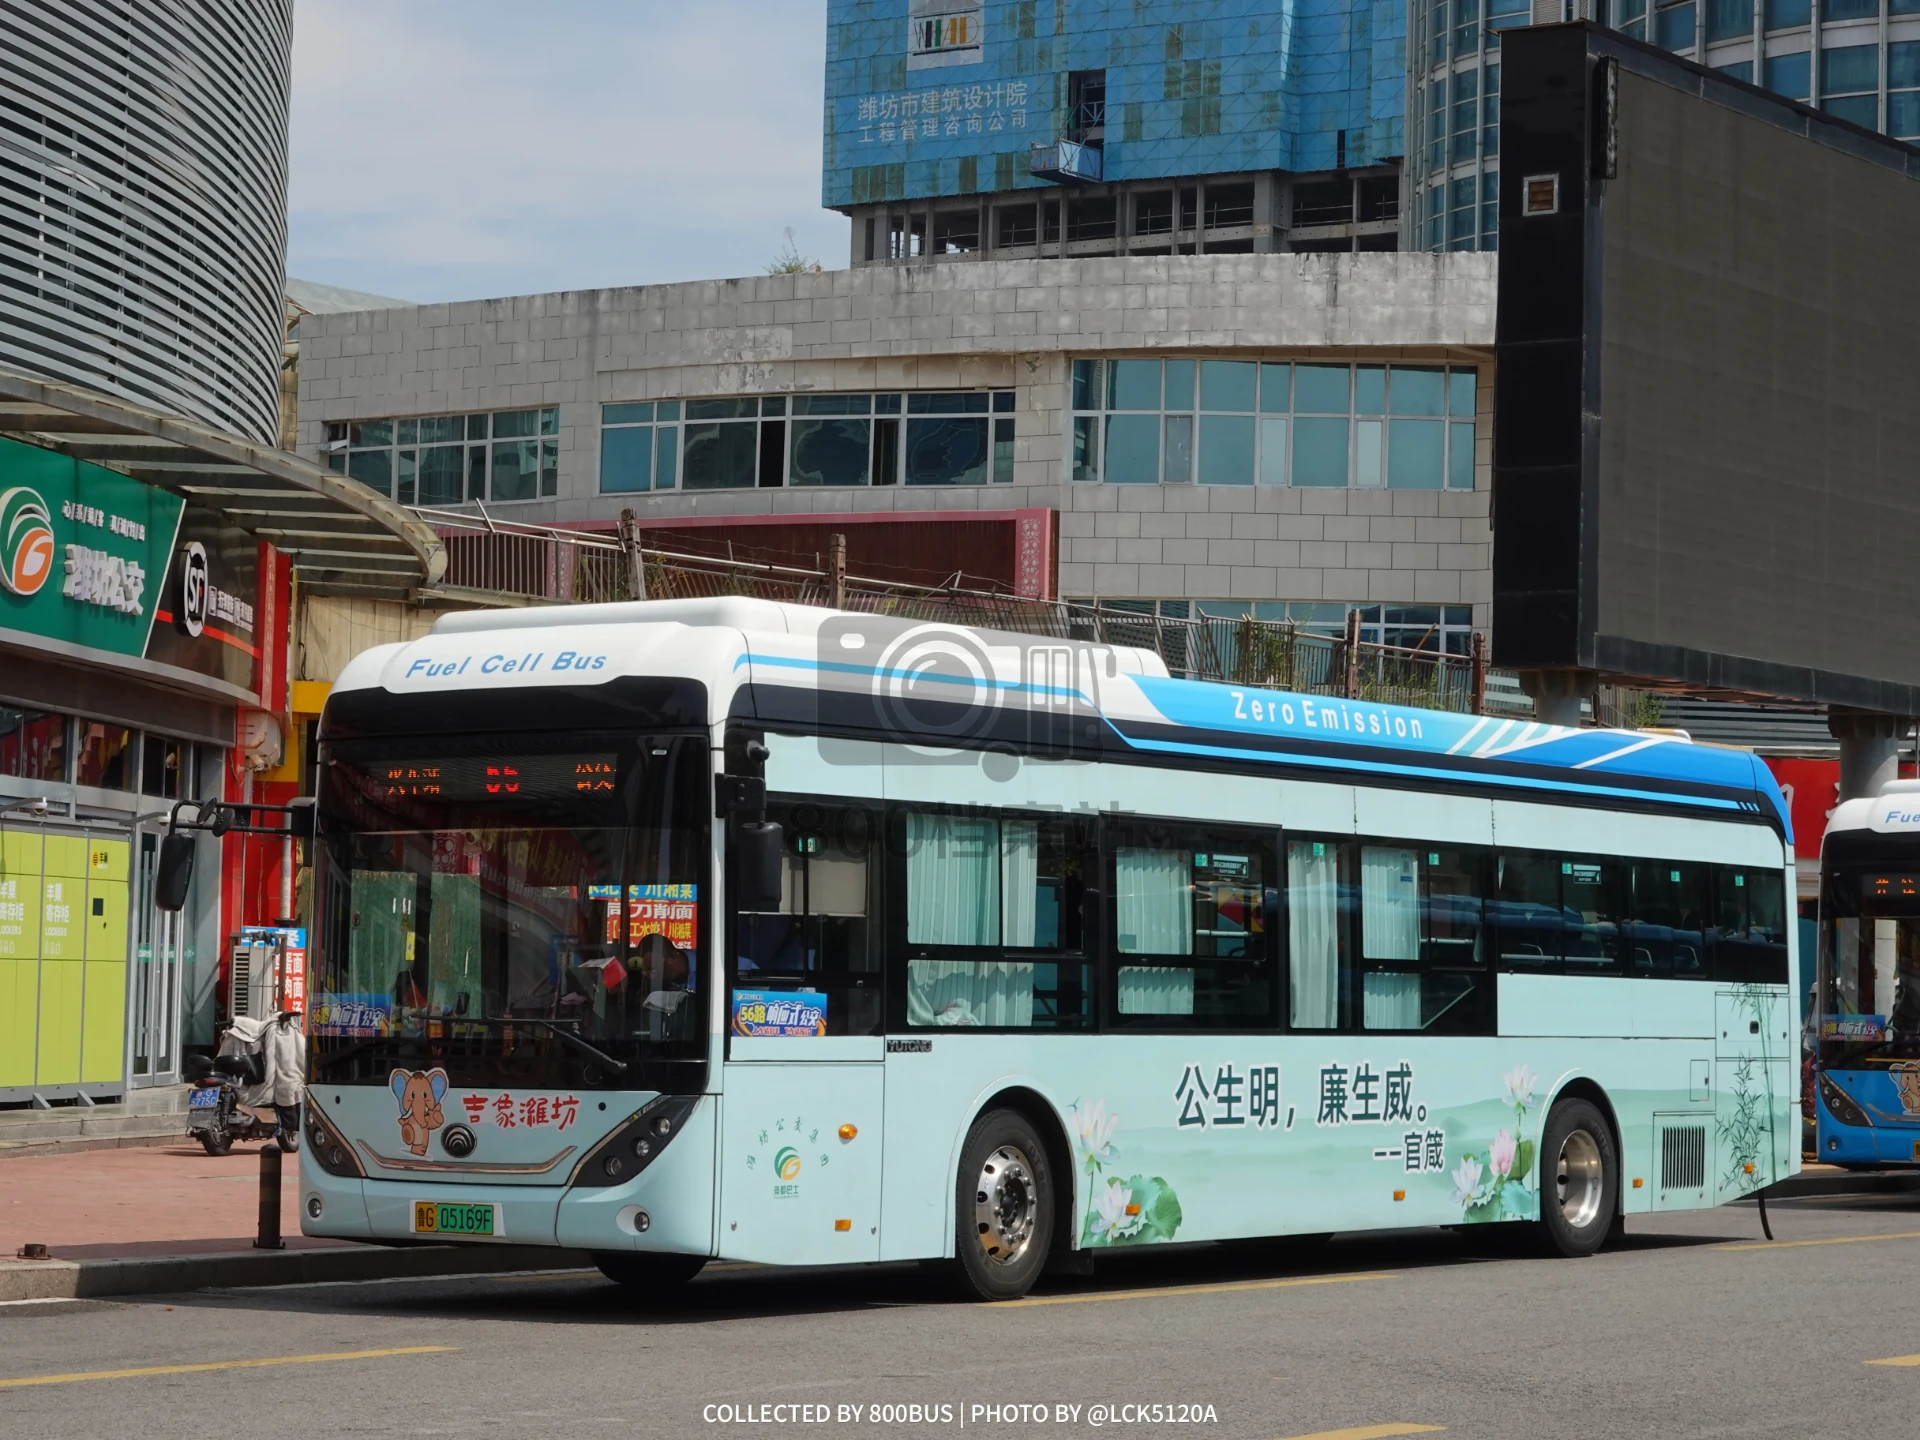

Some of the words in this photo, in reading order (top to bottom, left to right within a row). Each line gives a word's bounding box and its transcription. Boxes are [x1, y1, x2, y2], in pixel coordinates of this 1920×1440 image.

[858, 80, 1028, 121] 潍坊市建筑设计院
[858, 108, 1026, 143] 工程管理咨询公司
[405, 656, 472, 679] Fuel
[480, 652, 544, 674] Cell
[550, 651, 607, 671] Bus
[887, 1040, 932, 1052] YUTONG
